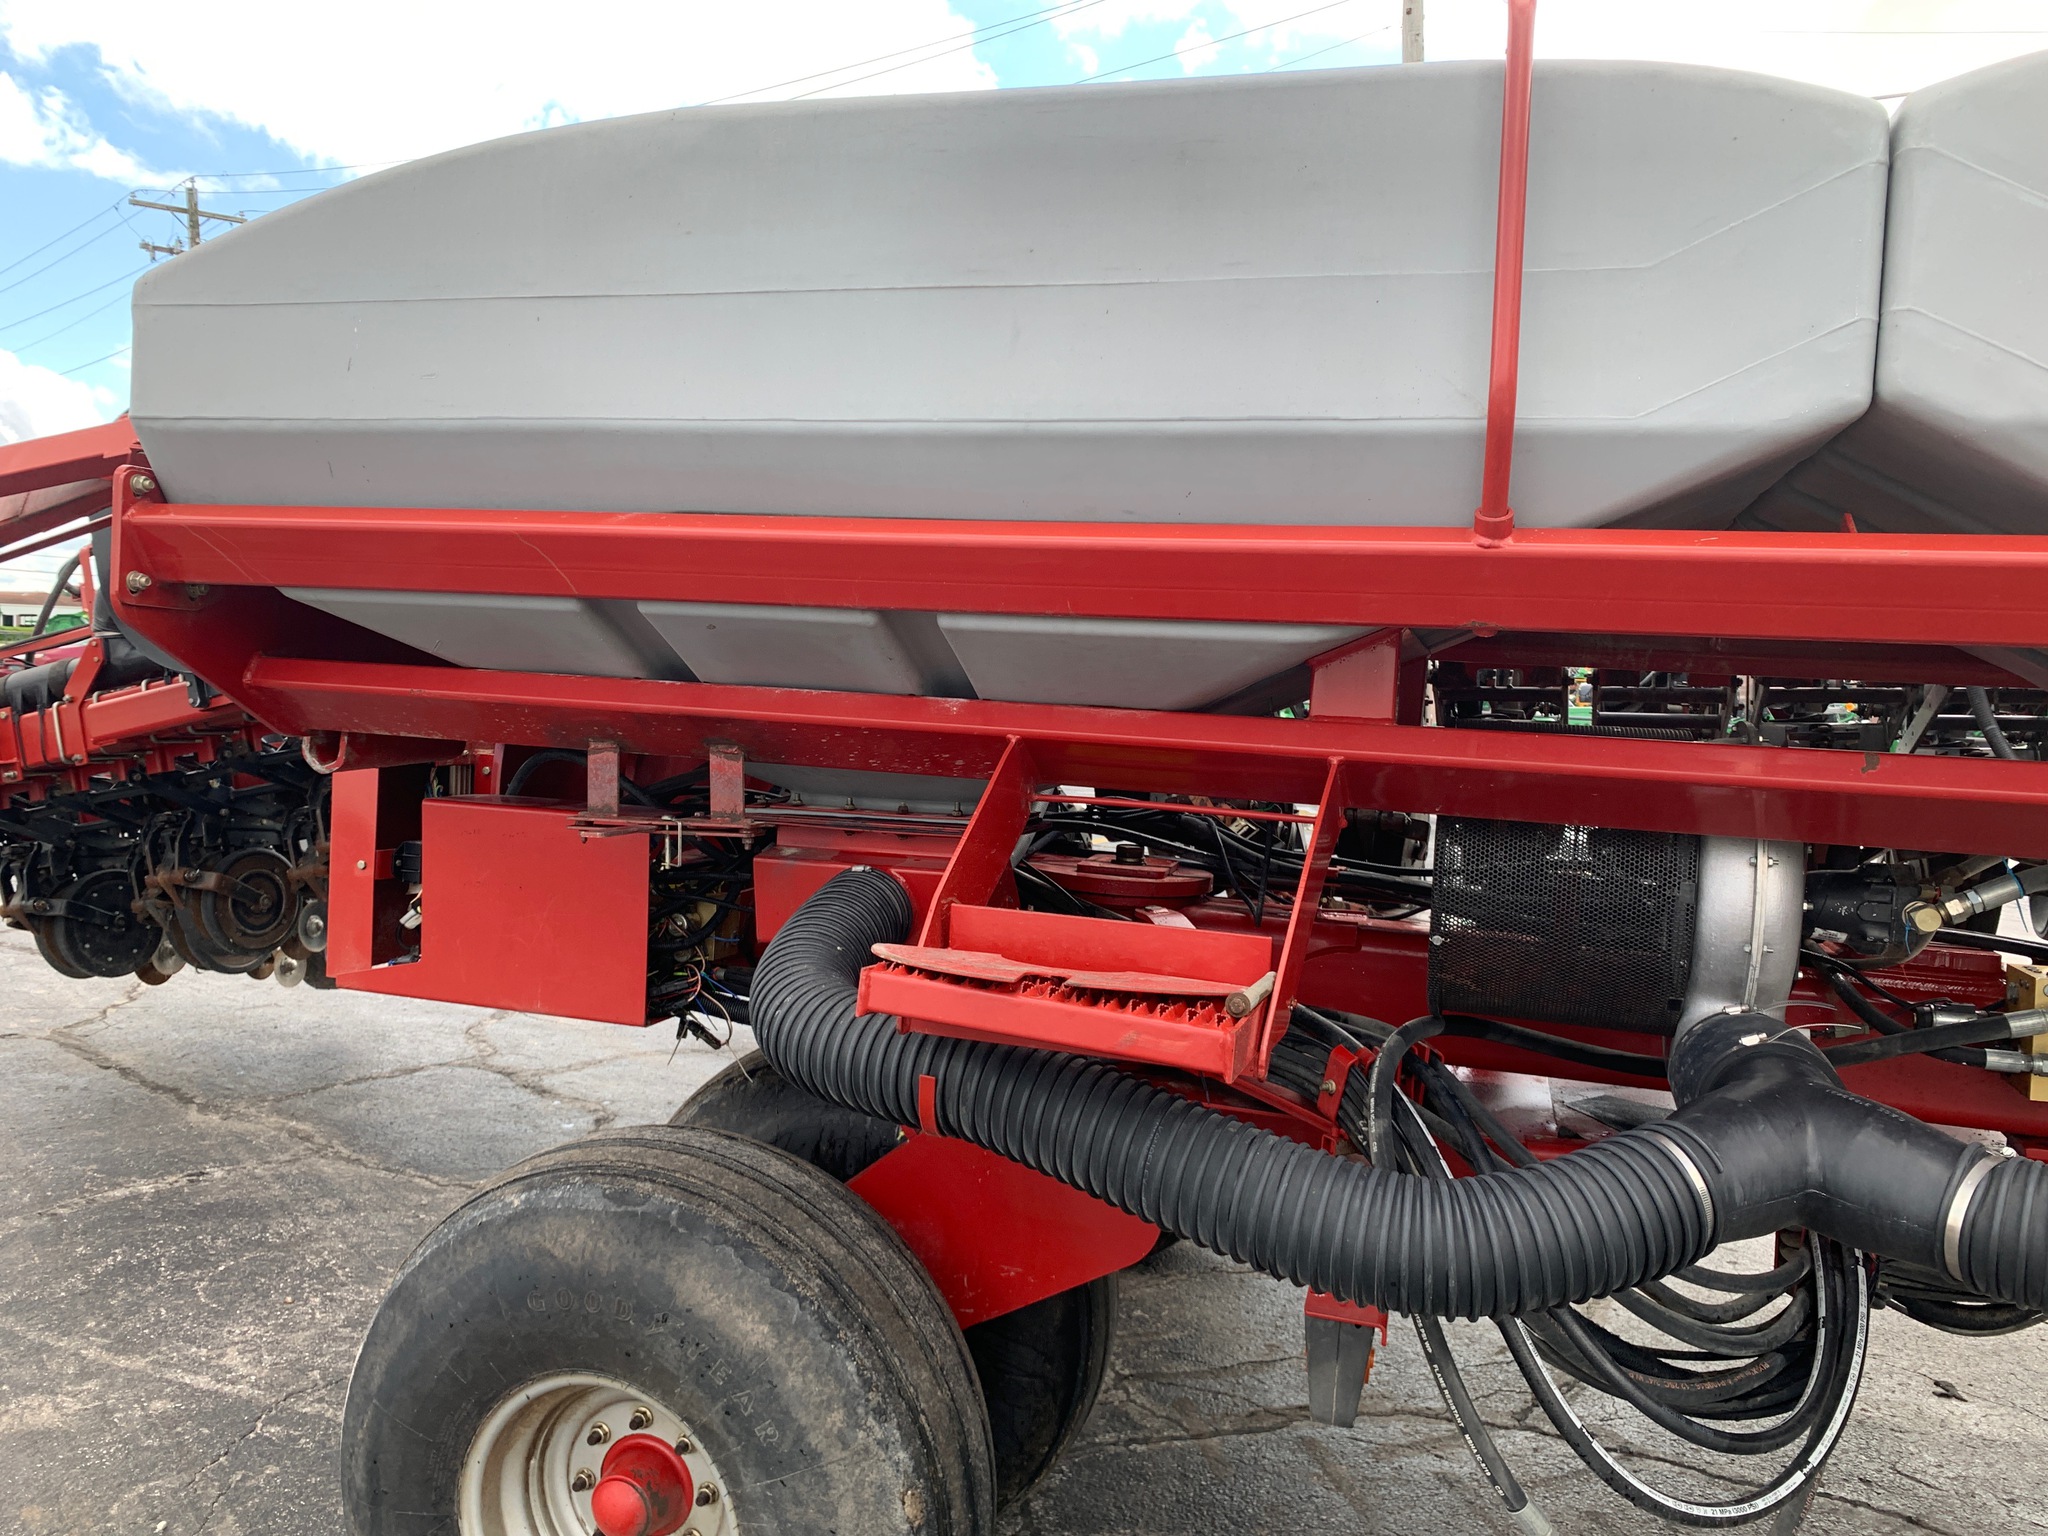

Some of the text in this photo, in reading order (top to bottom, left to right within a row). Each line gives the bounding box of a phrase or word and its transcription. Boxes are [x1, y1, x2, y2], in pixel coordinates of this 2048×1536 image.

[1433, 1364, 1446, 1389] FLAME
[1443, 1389, 1465, 1428] RESISTANT
[1719, 1507, 1732, 1516] MPa
[1732, 1505, 1748, 1515] (3000
